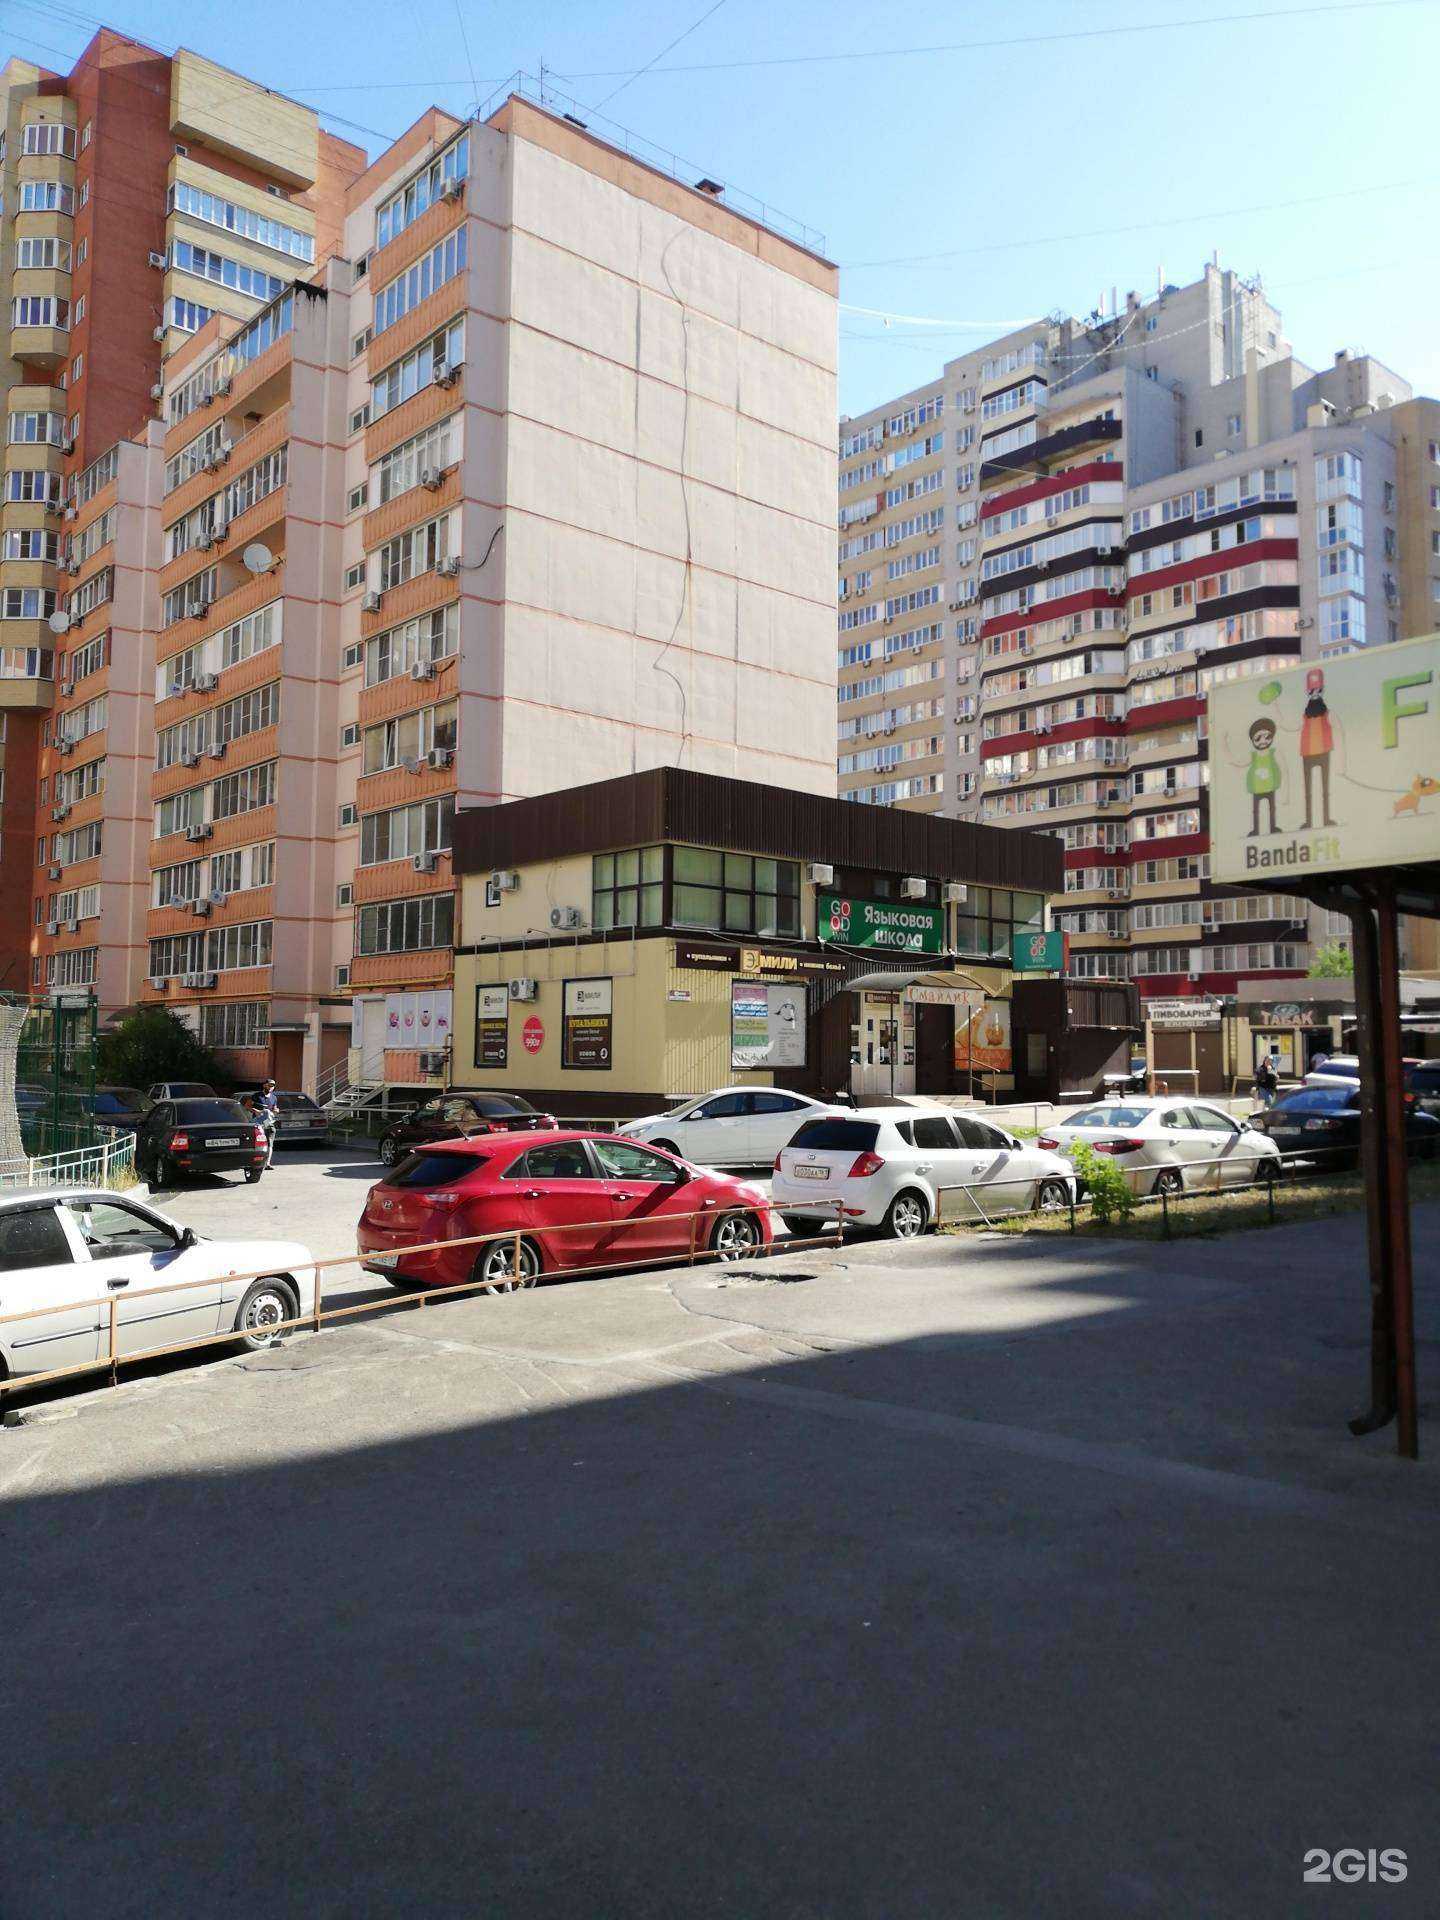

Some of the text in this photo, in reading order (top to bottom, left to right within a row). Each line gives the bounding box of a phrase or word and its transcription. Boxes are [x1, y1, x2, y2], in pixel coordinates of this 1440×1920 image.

[1382, 669, 1440, 750] F
[1246, 835, 1341, 869] BandaFit
[864, 905, 933, 929] Языковая
[1153, 1009, 1212, 1018] ПИВОВАРНЯ
[1260, 1010, 1314, 1026] ТАБАК
